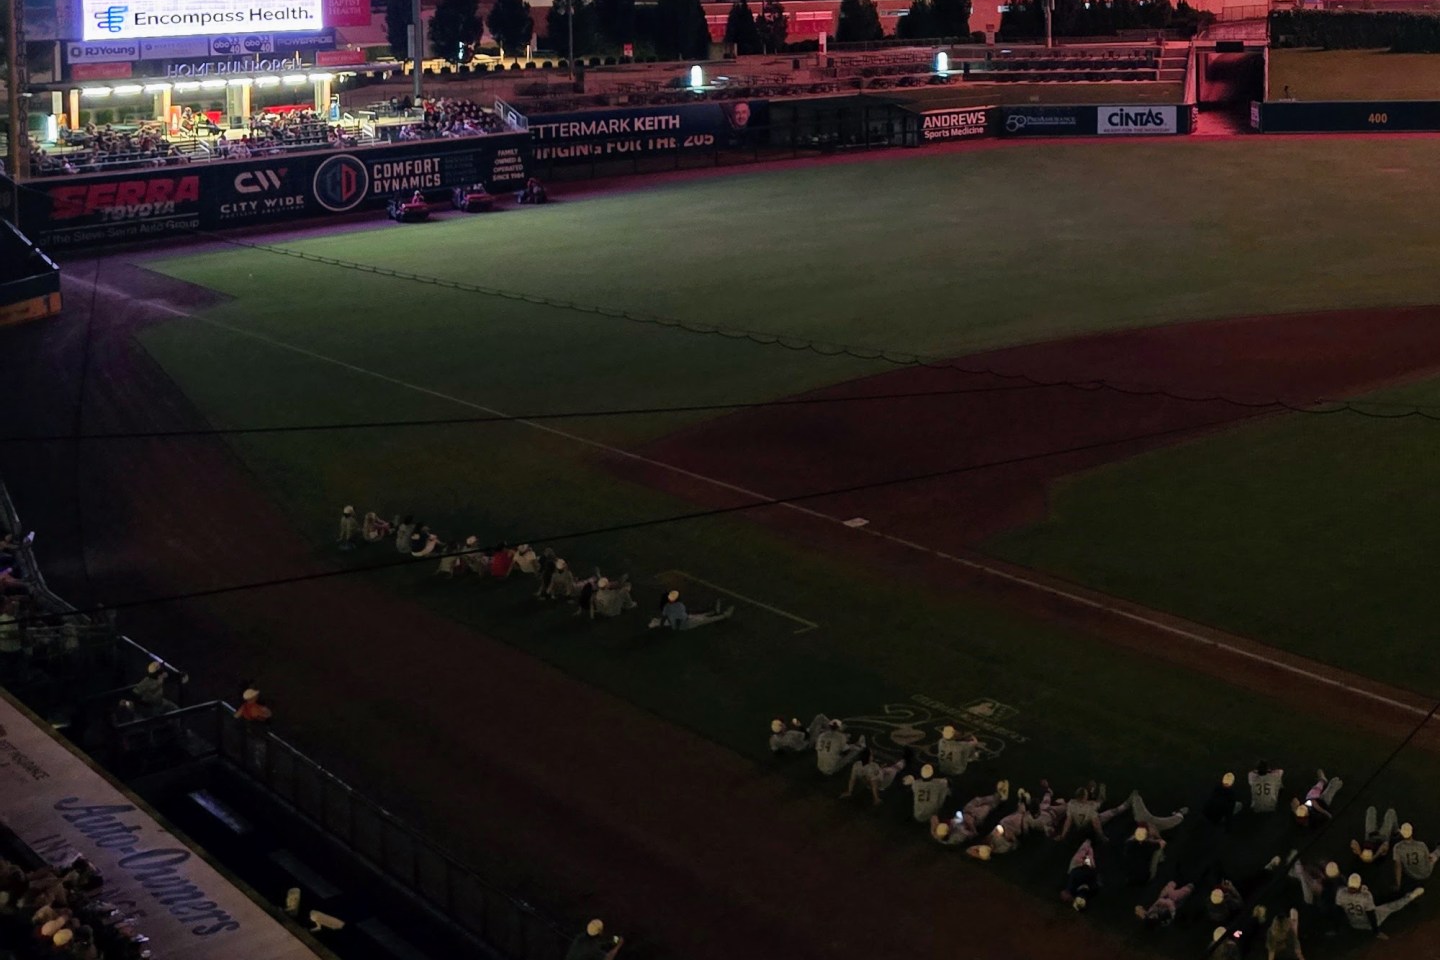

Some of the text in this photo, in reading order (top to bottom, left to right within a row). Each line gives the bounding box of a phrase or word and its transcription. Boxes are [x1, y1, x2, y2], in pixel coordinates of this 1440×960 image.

[329, 0, 361, 7] BAPTIST
[329, 7, 361, 15] HEALTH
[134, 10, 244, 26] Encompass
[167, 63, 215, 77] HOME
[217, 60, 248, 74] RUN
[634, 114, 680, 132] KEITH
[923, 111, 986, 128] ANDREWS
[1368, 113, 1388, 124] 400
[924, 125, 984, 140] Sports Medicine
[497, 148, 518, 157] FAMILY
[373, 157, 441, 179] COMFORT
[493, 164, 523, 173] OPERATED
[494, 157, 516, 165] OWNED
[373, 173, 441, 193] DYNAMICS
[50, 175, 200, 221] SERRA
[220, 194, 304, 214] CITY WIDE
[101, 200, 176, 221] TOYOTA
[53, 234, 71, 244] the
[140, 223, 163, 234] Auto
[165, 219, 200, 230] Group
[918, 791, 930, 802] 21
[1256, 783, 1270, 795] 36
[54, 797, 240, 936] Auto-Owners
[1406, 852, 1419, 865] 13
